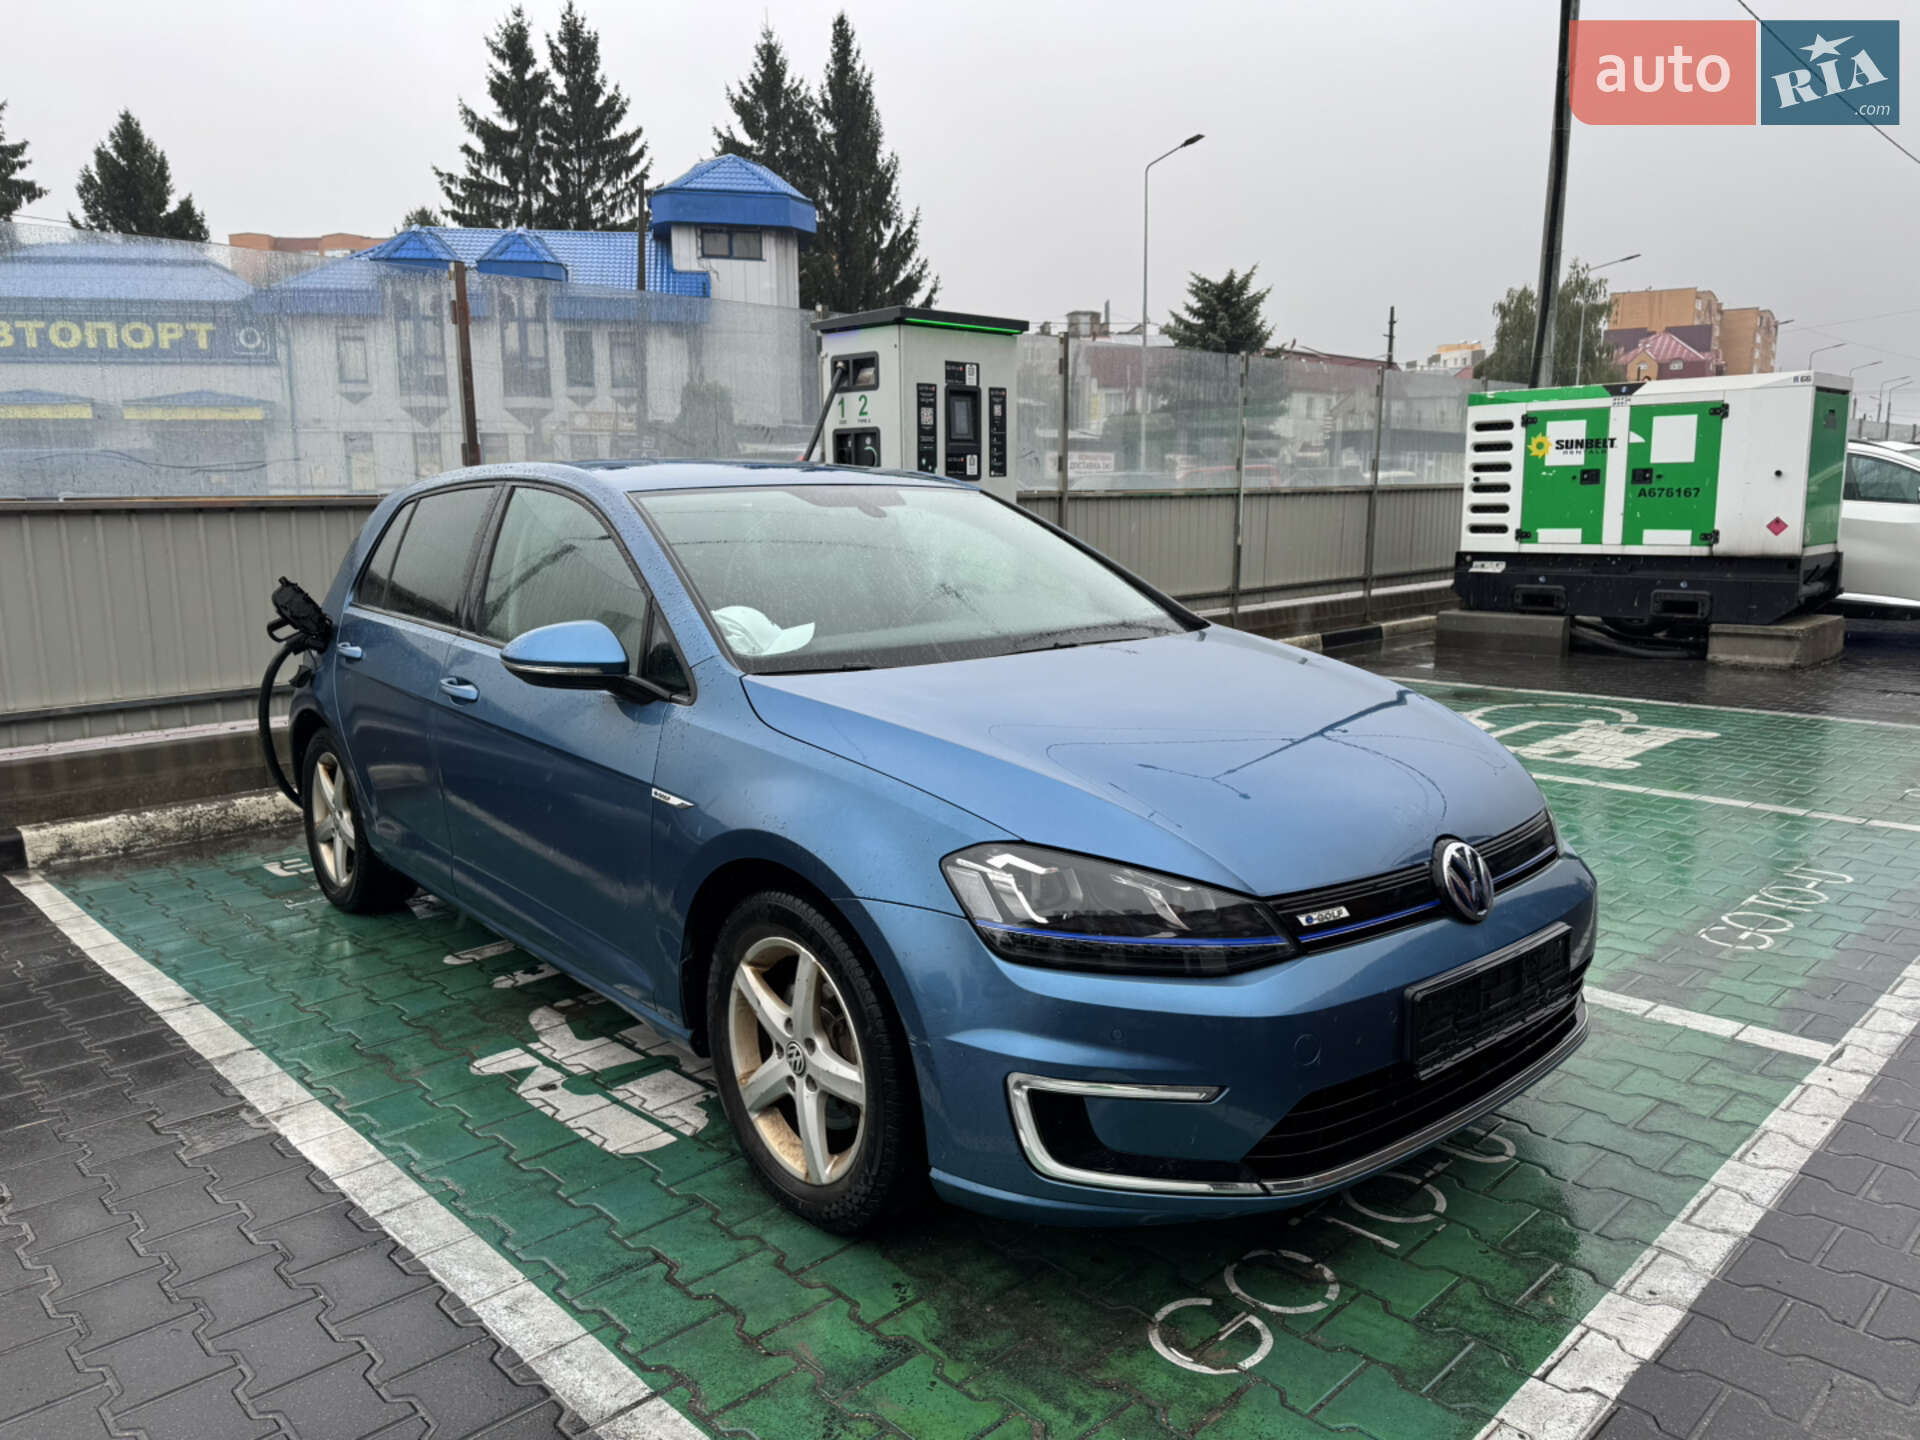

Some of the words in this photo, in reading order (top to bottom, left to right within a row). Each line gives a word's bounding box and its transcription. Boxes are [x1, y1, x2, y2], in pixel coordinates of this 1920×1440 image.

[838, 396, 845, 418] 1
[858, 394, 868, 417] 2
[1555, 437, 1617, 450] SUNBELT
